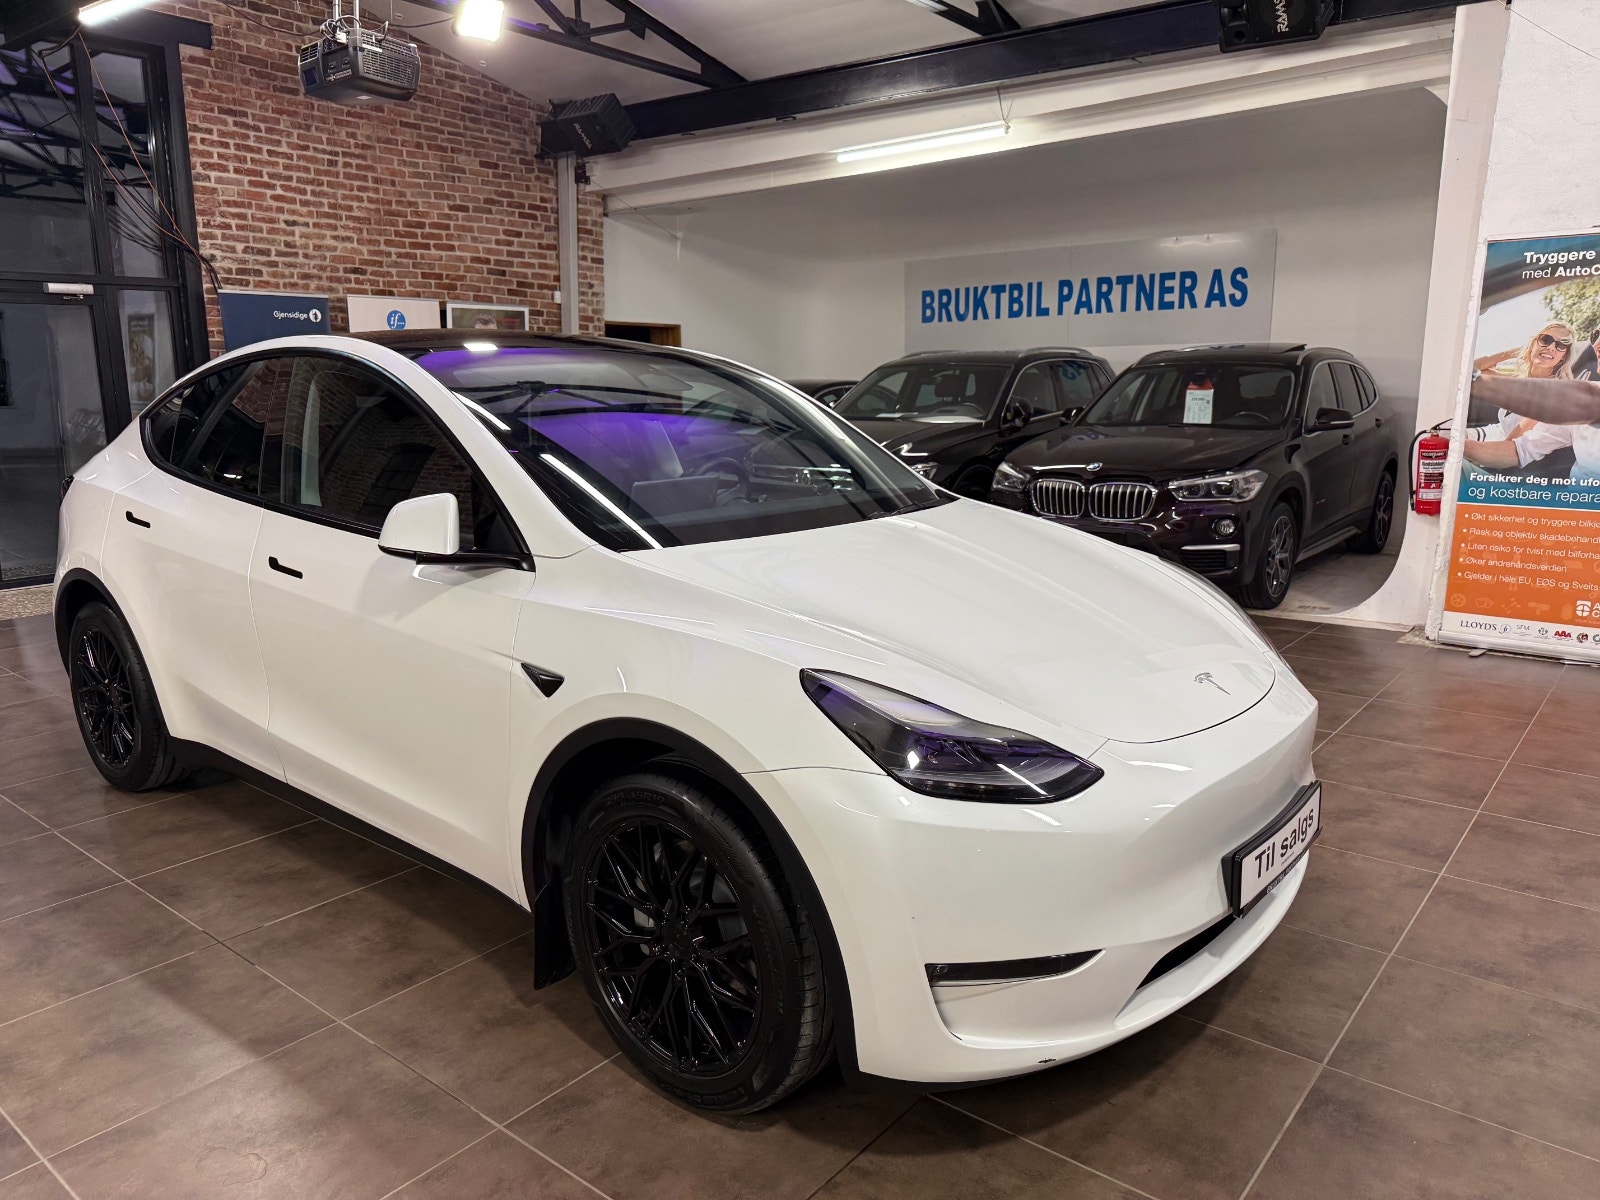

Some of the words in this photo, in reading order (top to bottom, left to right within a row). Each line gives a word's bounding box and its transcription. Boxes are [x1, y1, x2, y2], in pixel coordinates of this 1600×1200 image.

[1524, 250, 1596, 264] Tryggere
[1522, 267, 1551, 279] med
[1554, 264, 1600, 277] AutoC
[921, 281, 1050, 324] BRUKTBIL
[1057, 270, 1198, 316] PARTNER
[1204, 266, 1249, 308] AS
[273, 310, 308, 320] Gjensidige
[1469, 472, 1523, 483] Forsikrer
[1526, 475, 1548, 486] deg
[1551, 477, 1576, 486] mot
[1468, 487, 1485, 499] og
[1490, 486, 1551, 500] kostbare
[1471, 512, 1486, 520] Økt
[1488, 514, 1525, 523] sikkerhet
[1527, 517, 1539, 525] og
[1541, 517, 1577, 527] tryggere
[1469, 527, 1490, 536] Rask
[1492, 530, 1503, 538] og
[1505, 530, 1538, 540] objektiv
[1489, 544, 1511, 552] risiko
[1513, 545, 1525, 553] for
[1526, 546, 1543, 555] tvist
[1545, 549, 1566, 557] med
[1465, 556, 1486, 565] Øker
[1487, 559, 1567, 572] andrehåndsverdien
[1463, 571, 1492, 581] Gjelder
[1498, 574, 1517, 583] hele
[1536, 577, 1556, 587] EØS
[1558, 581, 1570, 590] og
[1572, 581, 1599, 591] Sveits
[1460, 620, 1497, 631] LLOYDS
[1254, 841, 1276, 879] Til
[1280, 808, 1314, 858] salgs
